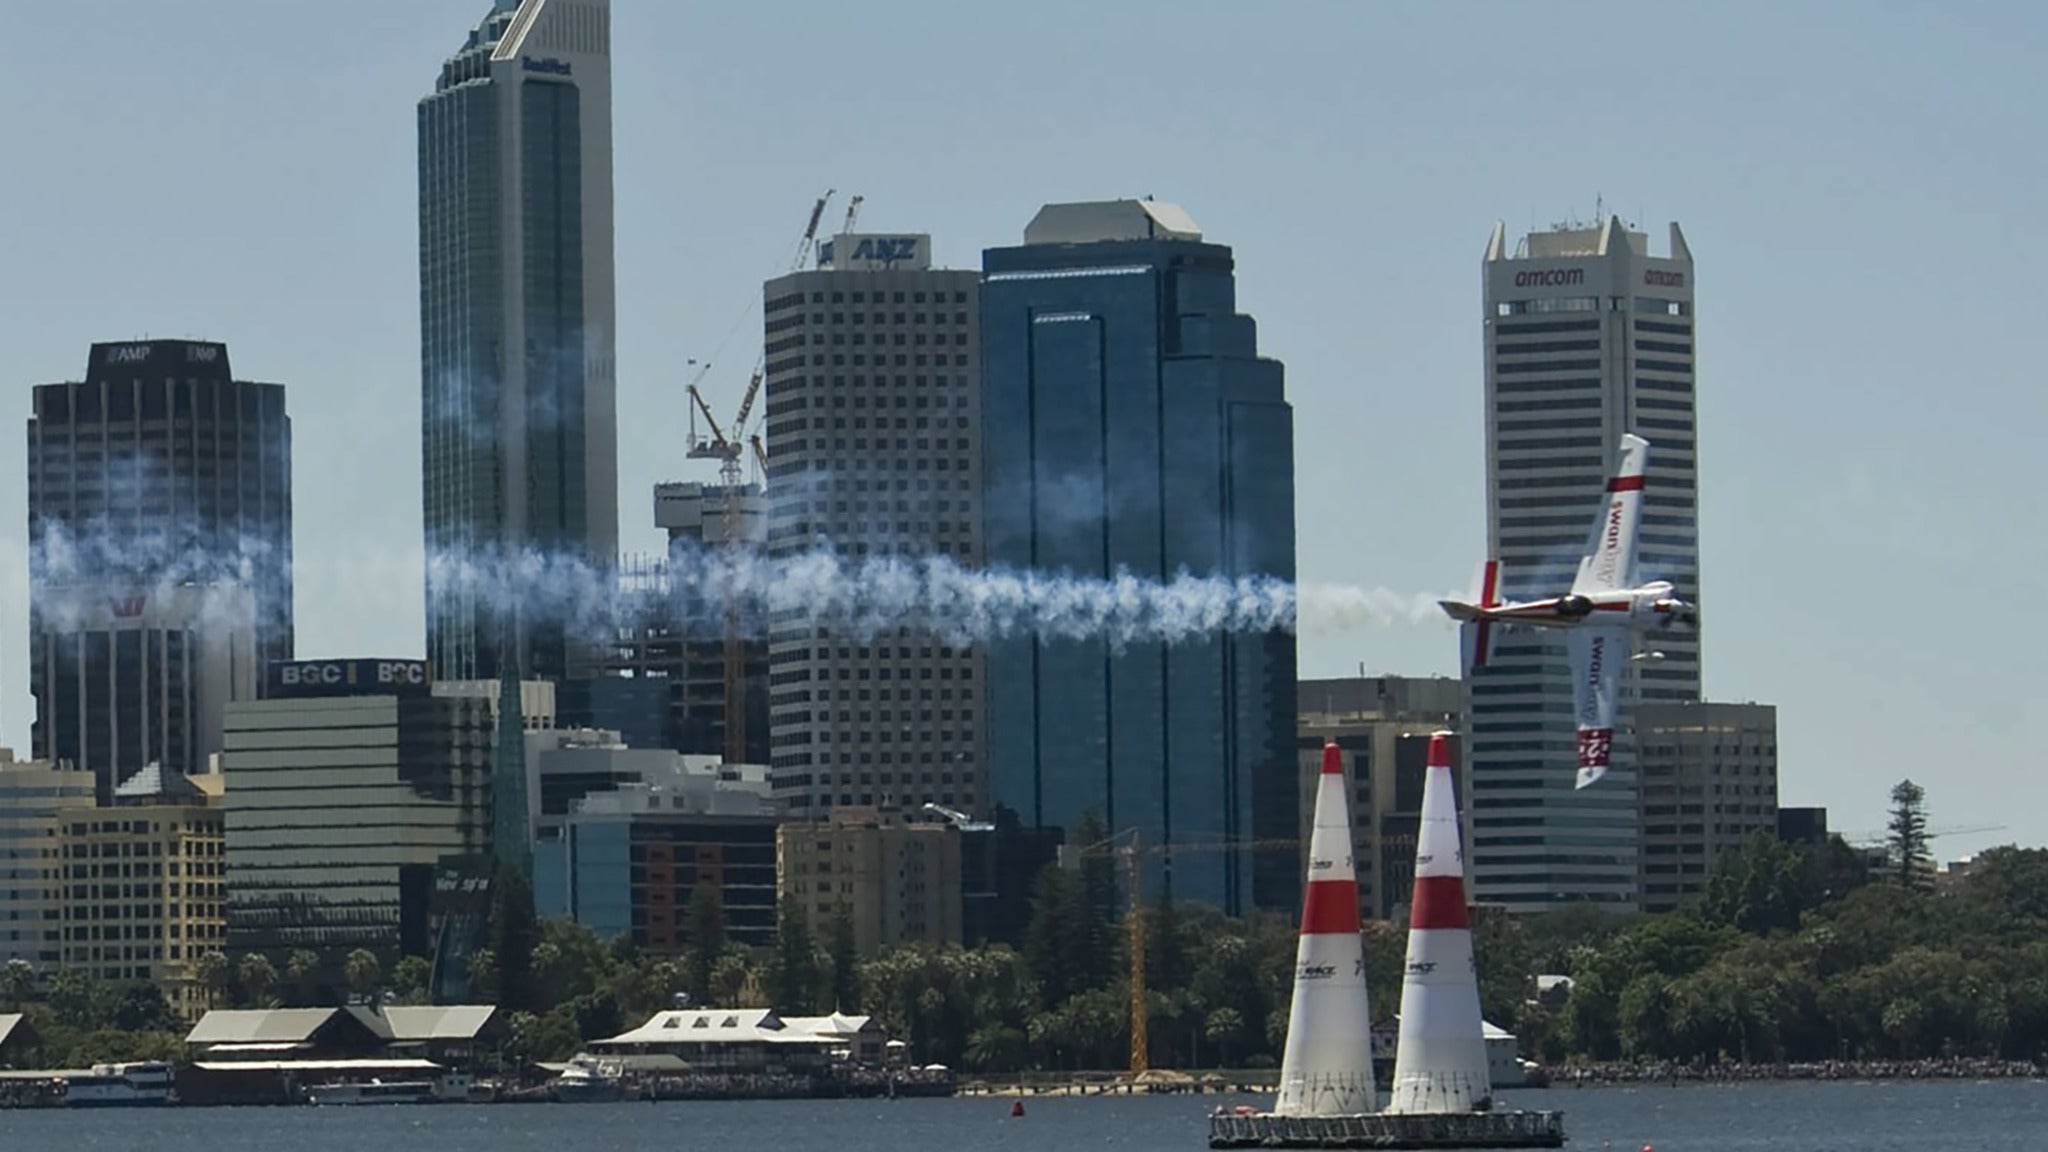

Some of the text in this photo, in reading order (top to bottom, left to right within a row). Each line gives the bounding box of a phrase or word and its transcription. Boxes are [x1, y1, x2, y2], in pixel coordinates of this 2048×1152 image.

[851, 238, 918, 260] ANZ
[1515, 268, 1585, 288] amcom
[1644, 269, 1685, 288] amcom
[118, 346, 150, 361] AMP
[1606, 501, 1623, 549] swan
[281, 664, 342, 685] BGC
